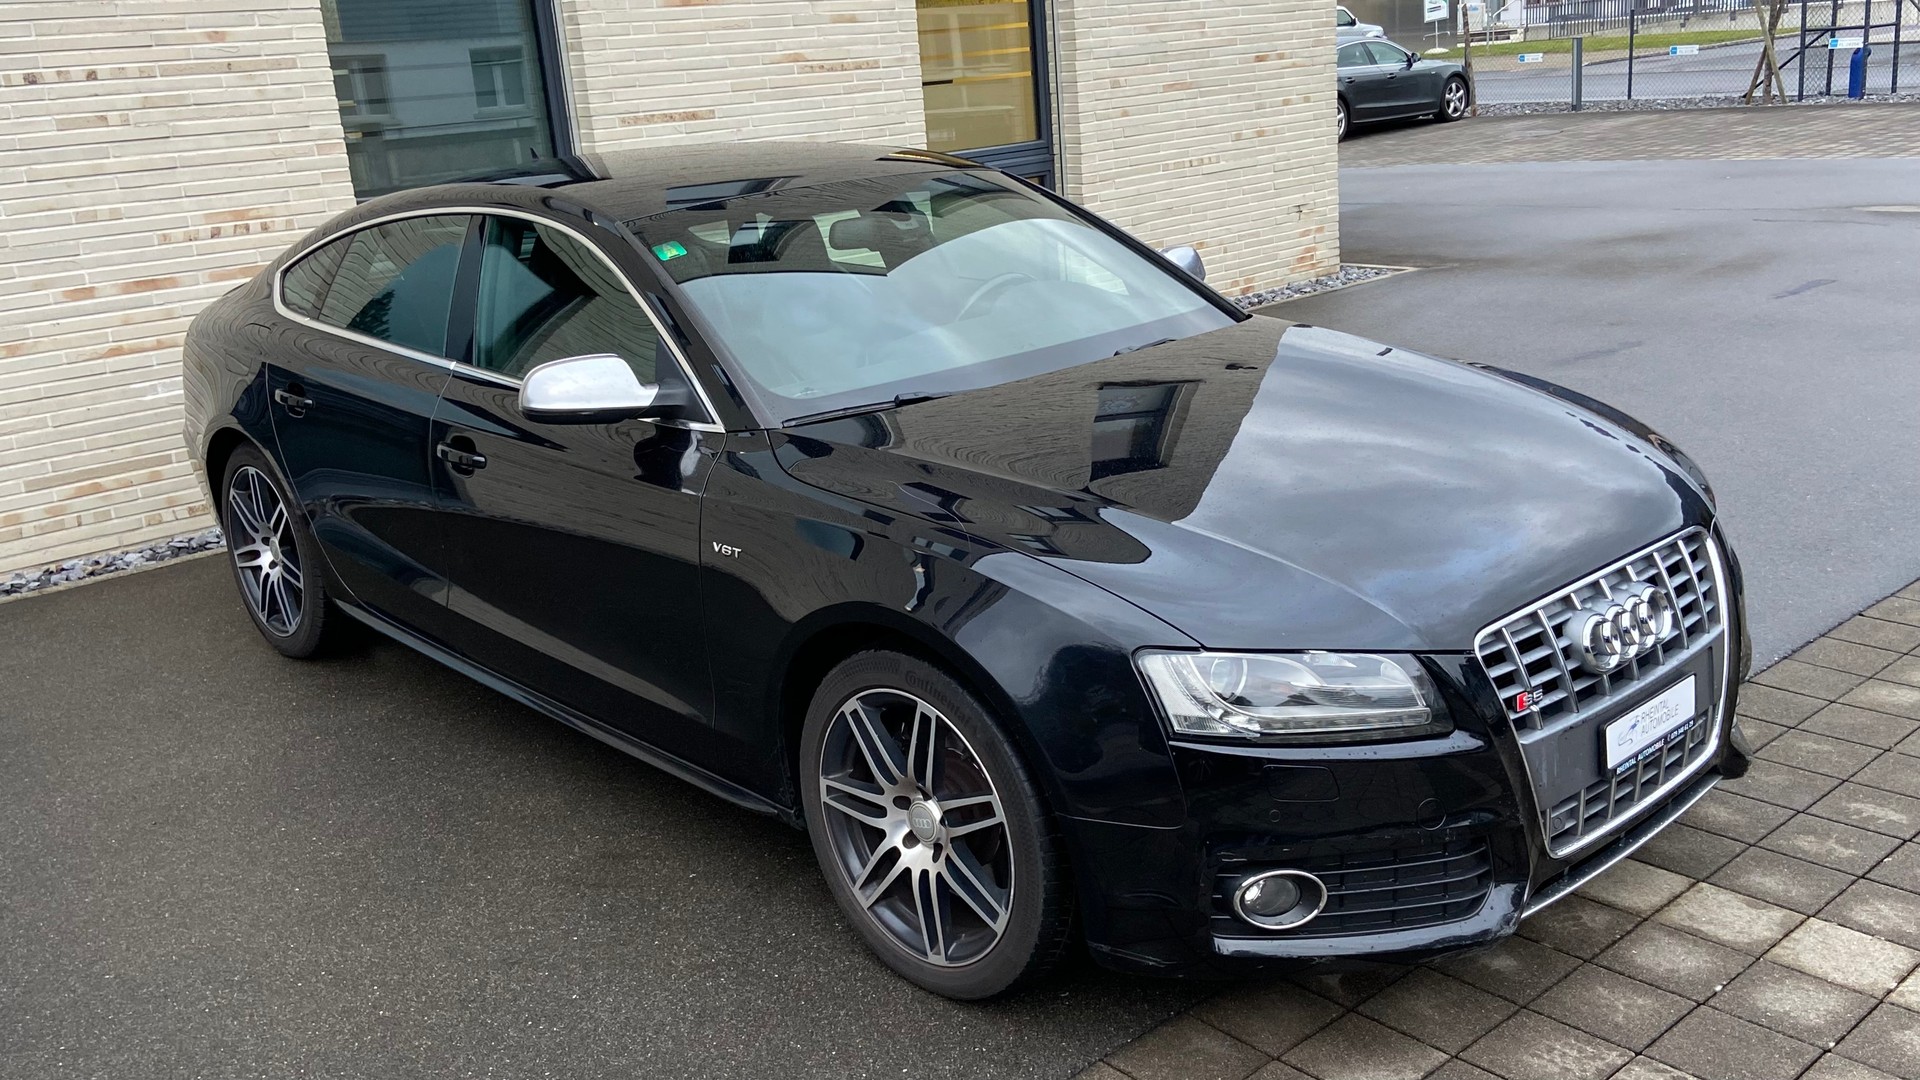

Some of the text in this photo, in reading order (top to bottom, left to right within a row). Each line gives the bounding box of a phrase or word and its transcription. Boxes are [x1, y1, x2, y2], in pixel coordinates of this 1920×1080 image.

[712, 541, 742, 558] V6T
[905, 670, 972, 724] Continental
[1519, 689, 1543, 707] S5
[1641, 698, 1669, 721] RHEINTAL
[1641, 704, 1679, 736] AUTOMOBILE
[1616, 757, 1637, 775] RHEINTAL
[1637, 738, 1665, 761] AUTOMOBILE
